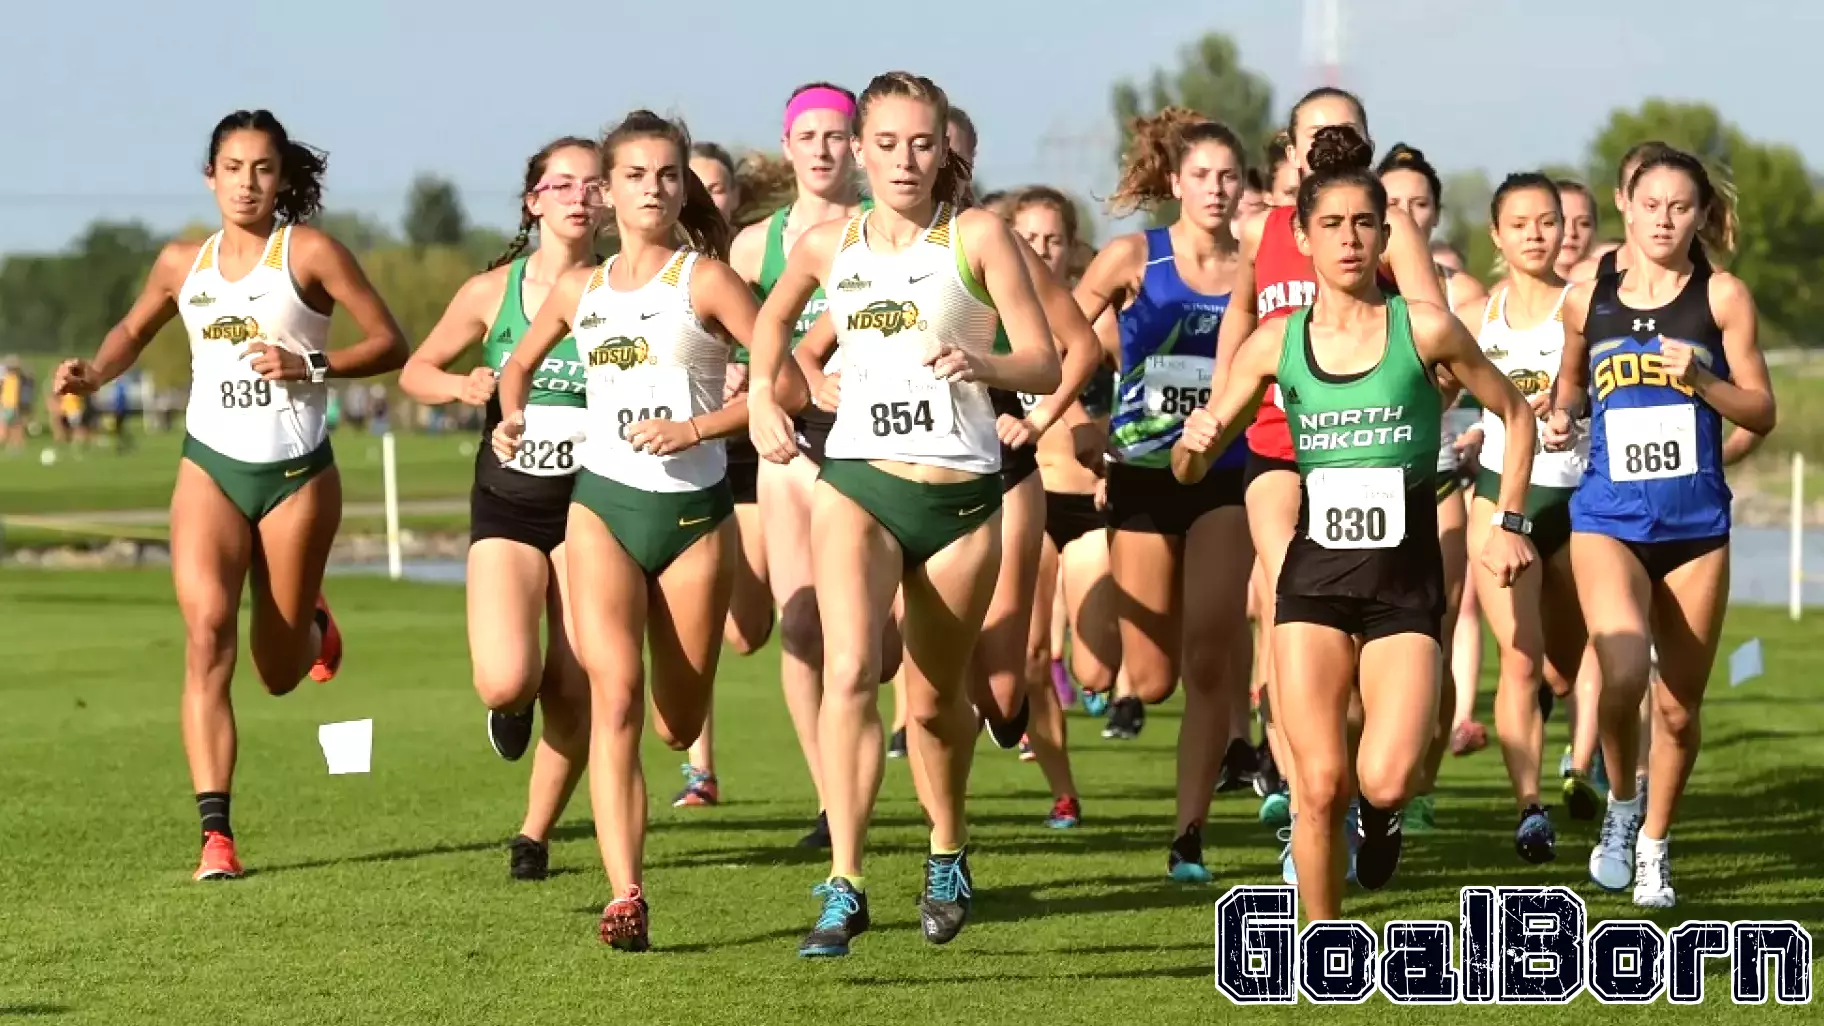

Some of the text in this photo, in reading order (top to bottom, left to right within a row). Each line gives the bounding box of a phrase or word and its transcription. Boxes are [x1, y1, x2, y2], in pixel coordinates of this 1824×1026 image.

[1258, 280, 1317, 319] SPART
[202, 322, 242, 341] NDSU
[847, 311, 899, 331] NDSU
[587, 347, 632, 366] NDSU
[220, 378, 272, 409] 839
[870, 400, 935, 437] 854
[1298, 405, 1404, 431] NORTH
[1299, 424, 1413, 451] DAKOTA
[519, 439, 574, 470] 828
[1625, 440, 1681, 474] 869
[1326, 507, 1386, 542] 830
